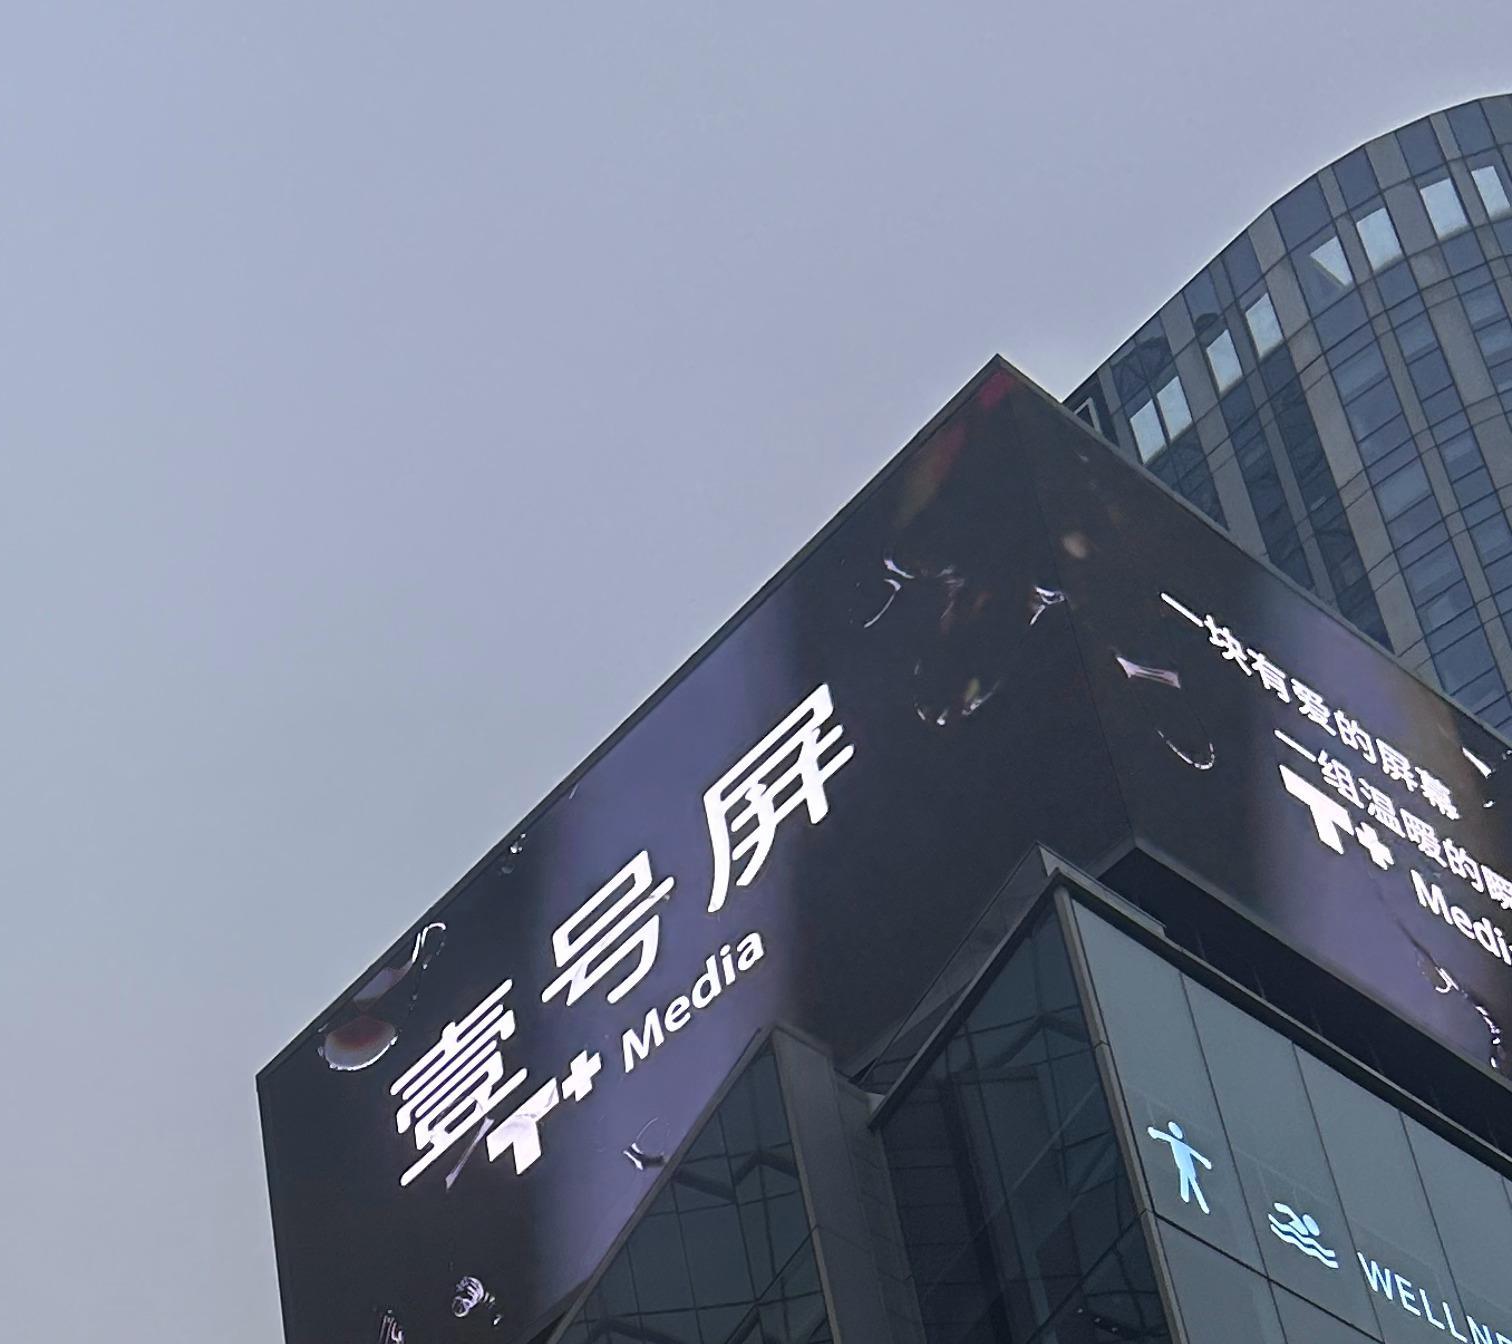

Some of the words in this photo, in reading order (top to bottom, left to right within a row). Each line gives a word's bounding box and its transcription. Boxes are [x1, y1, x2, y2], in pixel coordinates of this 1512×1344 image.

[1161, 593, 1461, 820] 一块有爱的屏幕
[389, 682, 855, 1187] 壹号屏
[621, 931, 766, 1074] Media
[1410, 869, 1512, 966] Medi
